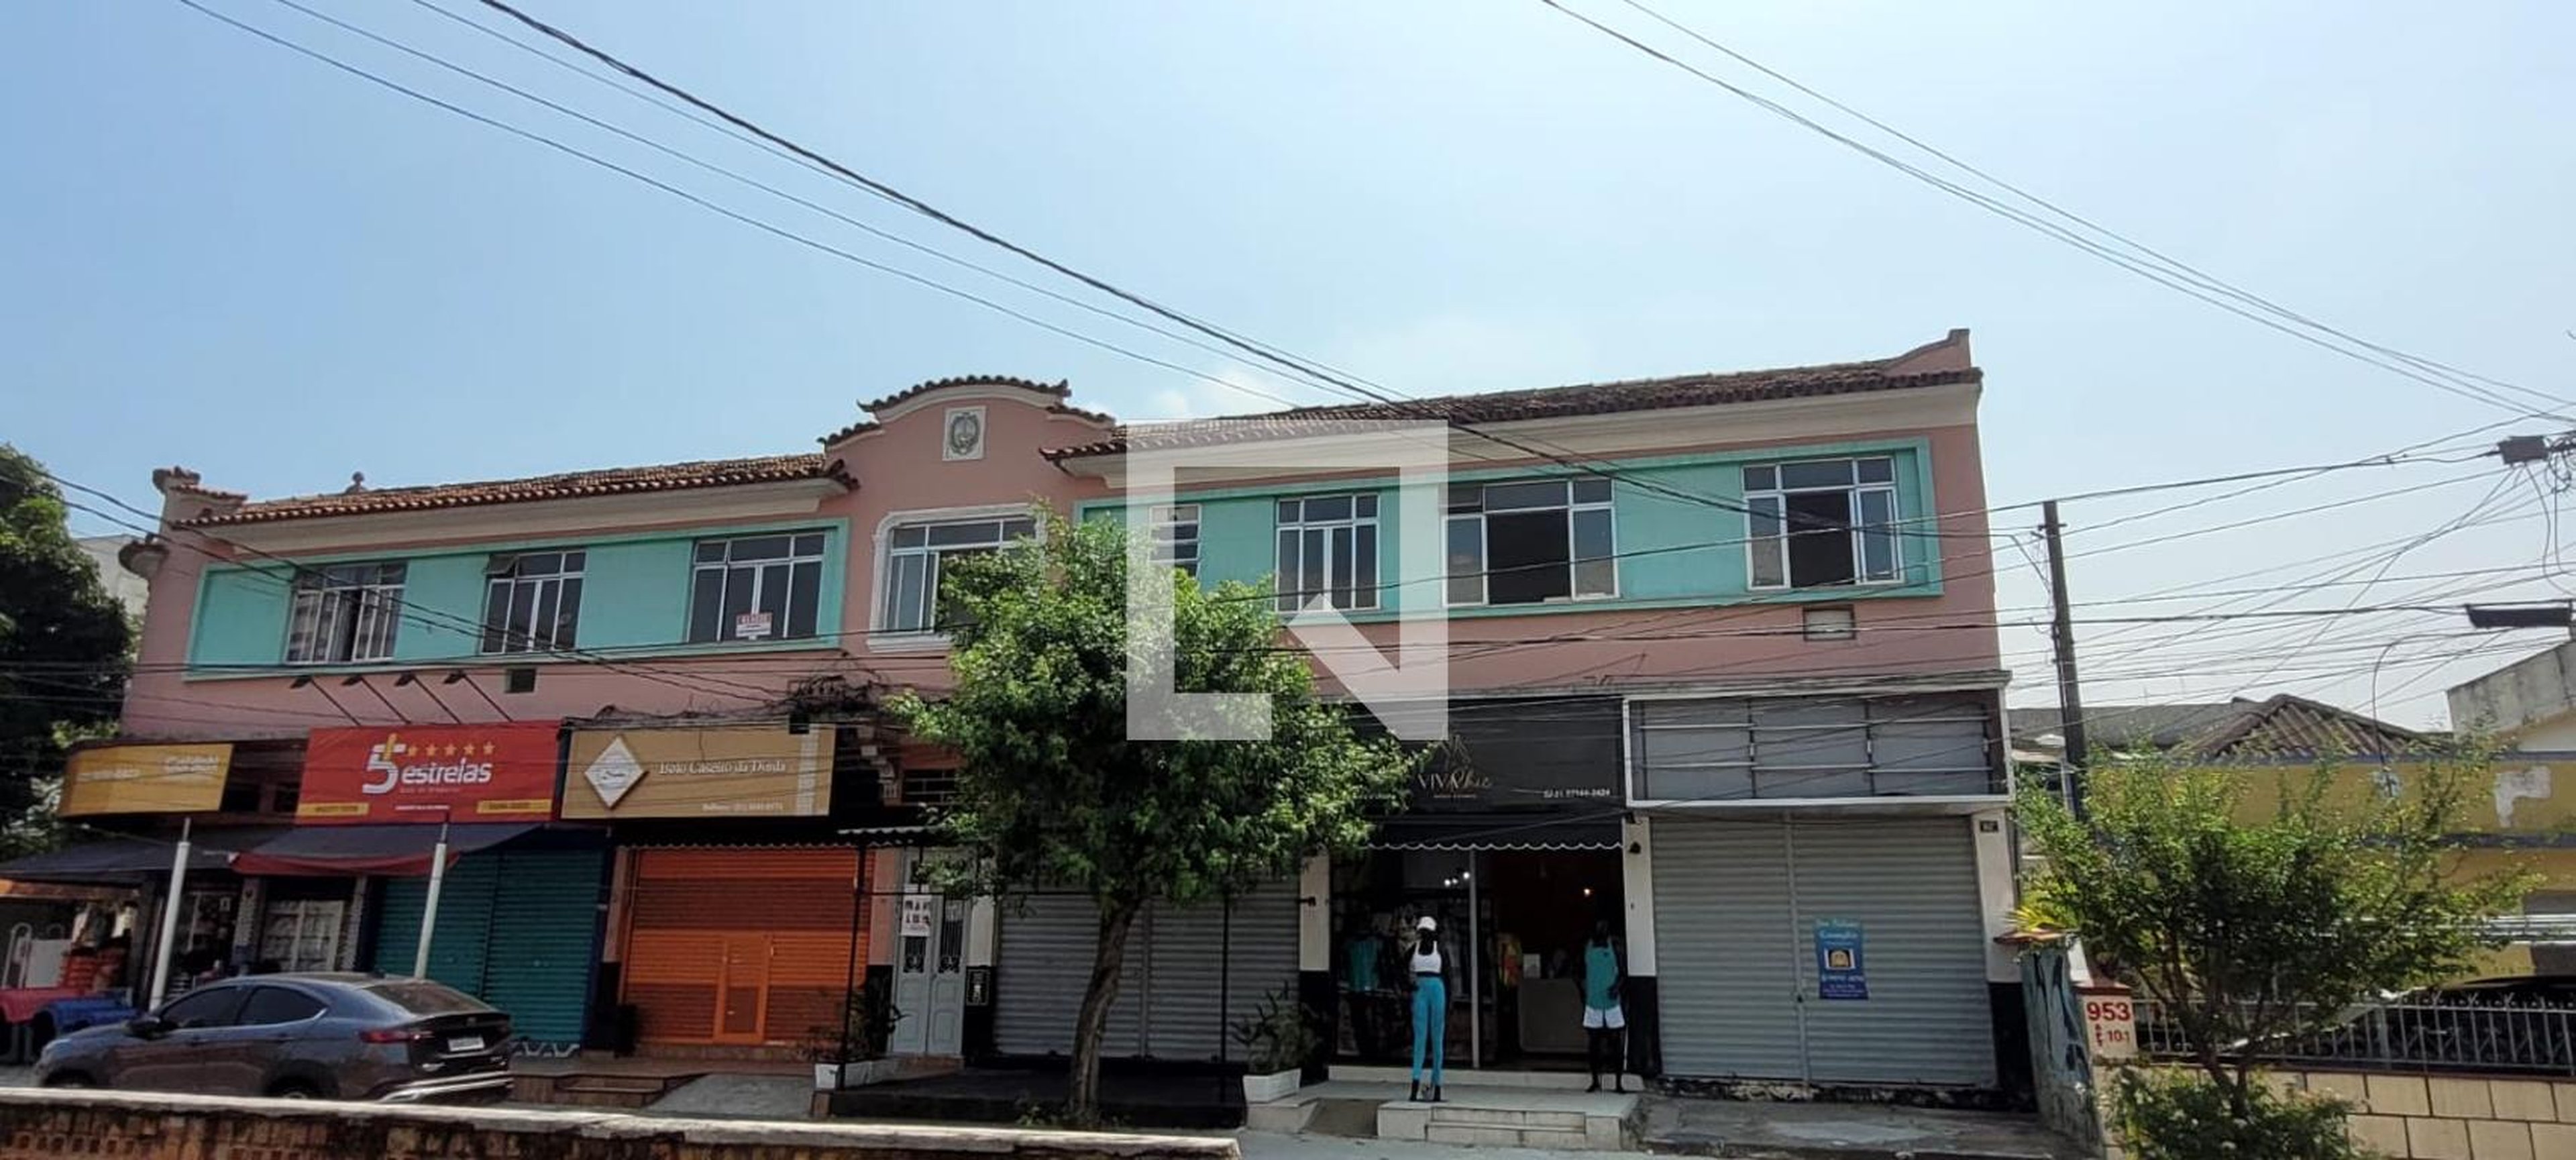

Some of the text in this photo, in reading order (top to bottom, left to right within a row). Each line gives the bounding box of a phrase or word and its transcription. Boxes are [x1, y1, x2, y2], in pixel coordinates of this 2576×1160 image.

[362, 733, 493, 794] 5 estrelas
[2086, 1002, 2131, 1021] 953
